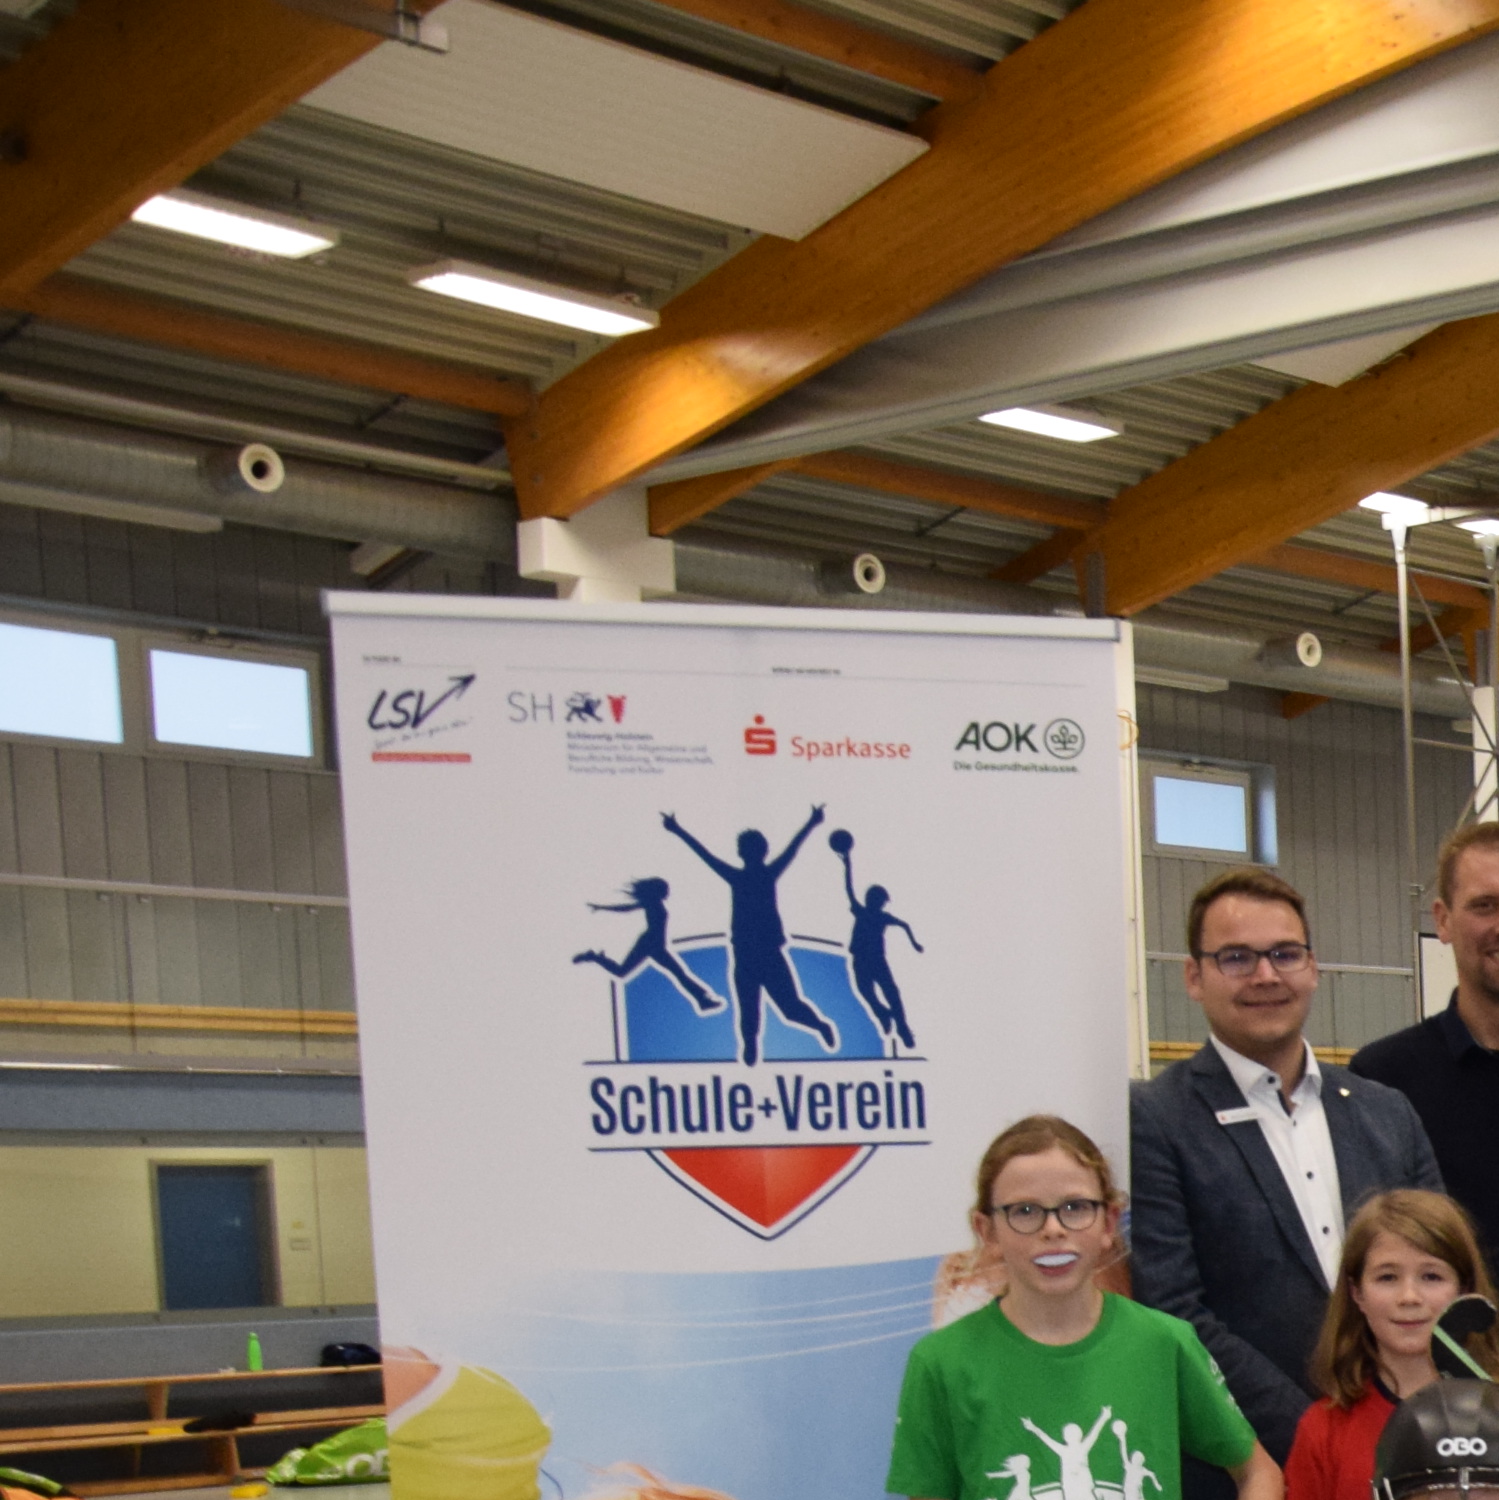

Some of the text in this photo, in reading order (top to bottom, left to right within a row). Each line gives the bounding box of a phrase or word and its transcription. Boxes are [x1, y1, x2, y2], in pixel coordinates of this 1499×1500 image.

[367, 683, 457, 730] LSV
[507, 691, 554, 723] SH
[791, 736, 911, 761] Sparkasse
[955, 721, 1039, 753] AOK
[954, 760, 968, 771] Die
[590, 1071, 927, 1135] Schule+Verein
[1436, 1436, 1488, 1457] OBO
